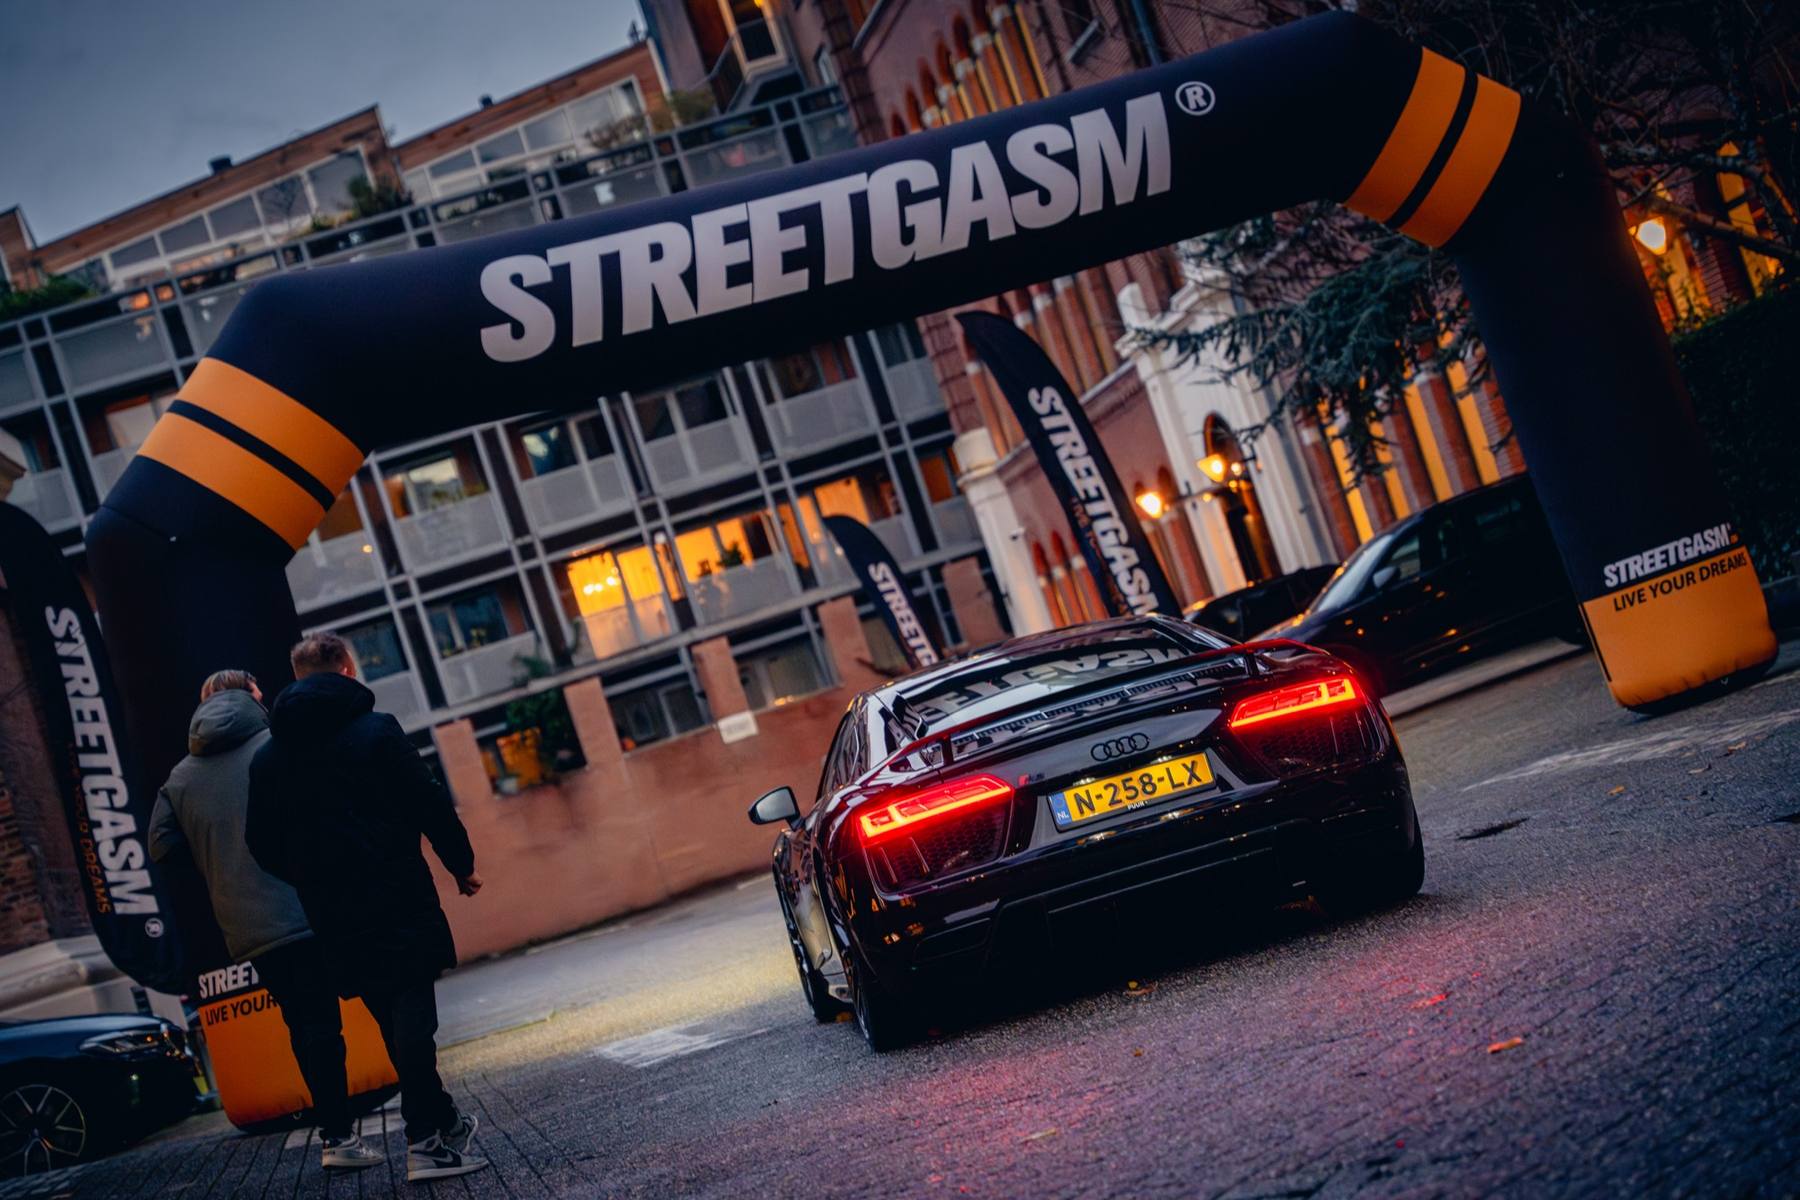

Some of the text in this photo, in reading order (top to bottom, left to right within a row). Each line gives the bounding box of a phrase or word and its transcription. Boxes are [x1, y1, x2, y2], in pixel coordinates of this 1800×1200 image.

[480, 92, 1172, 363] STREETGASM
[1613, 552, 1747, 612] LIVE YOUR DREAMS
[45, 605, 159, 915] STREETGASM
[1073, 760, 1203, 816] N-258-LX
[205, 995, 278, 1026] LIVE YOUR
